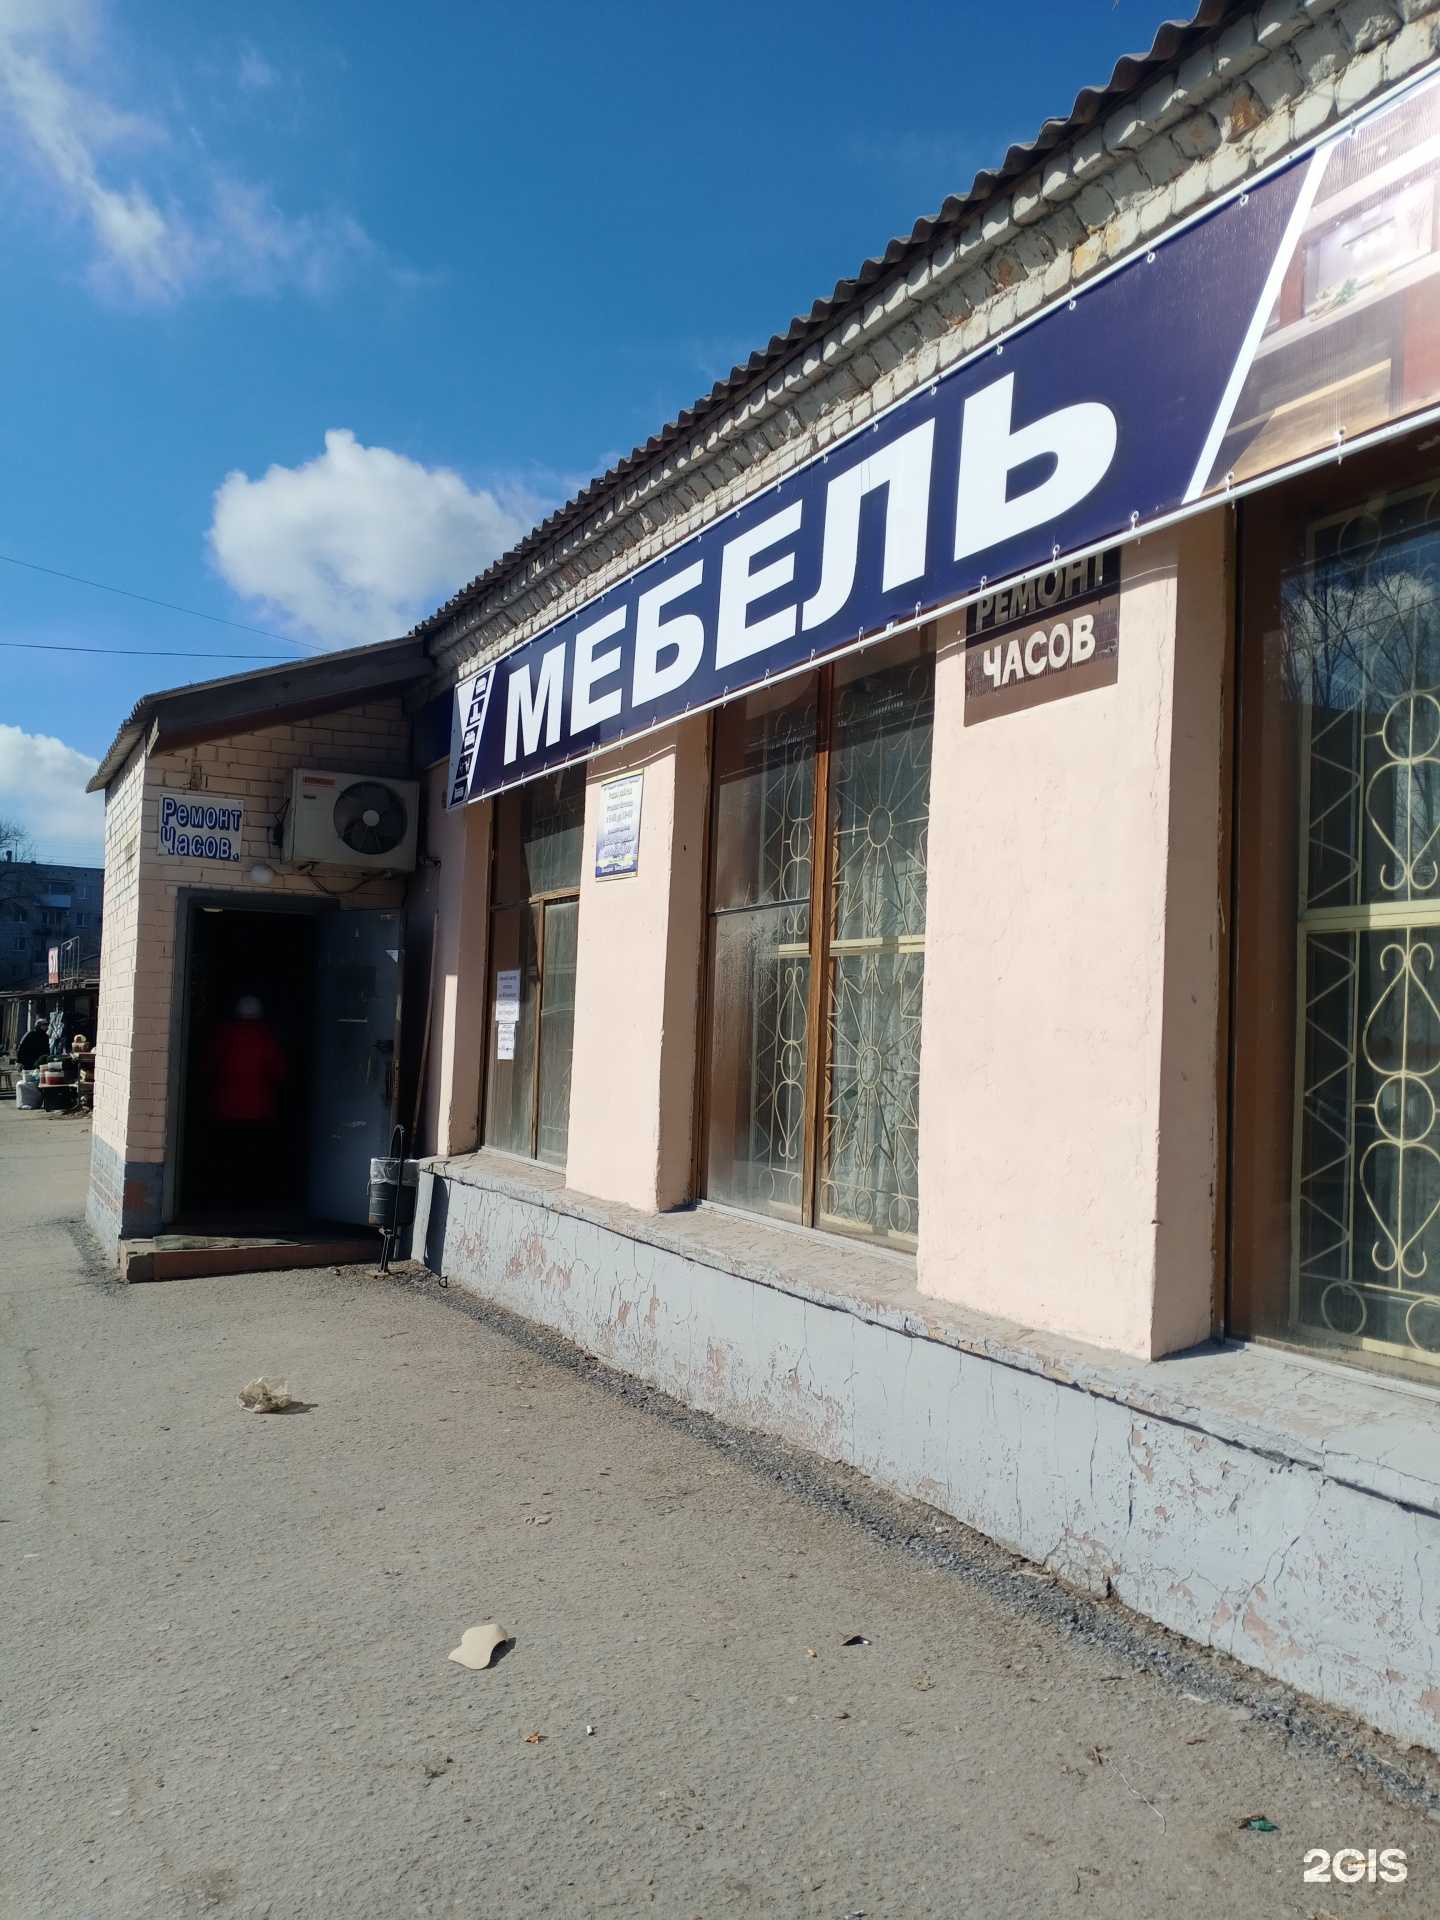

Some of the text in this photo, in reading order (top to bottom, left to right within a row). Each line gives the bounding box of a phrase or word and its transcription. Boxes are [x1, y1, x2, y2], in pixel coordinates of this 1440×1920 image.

[504, 372, 1117, 766] МЕБЕЛЬ
[983, 614, 1096, 688] ЧАСОВ
[162, 797, 242, 832] Ремонт
